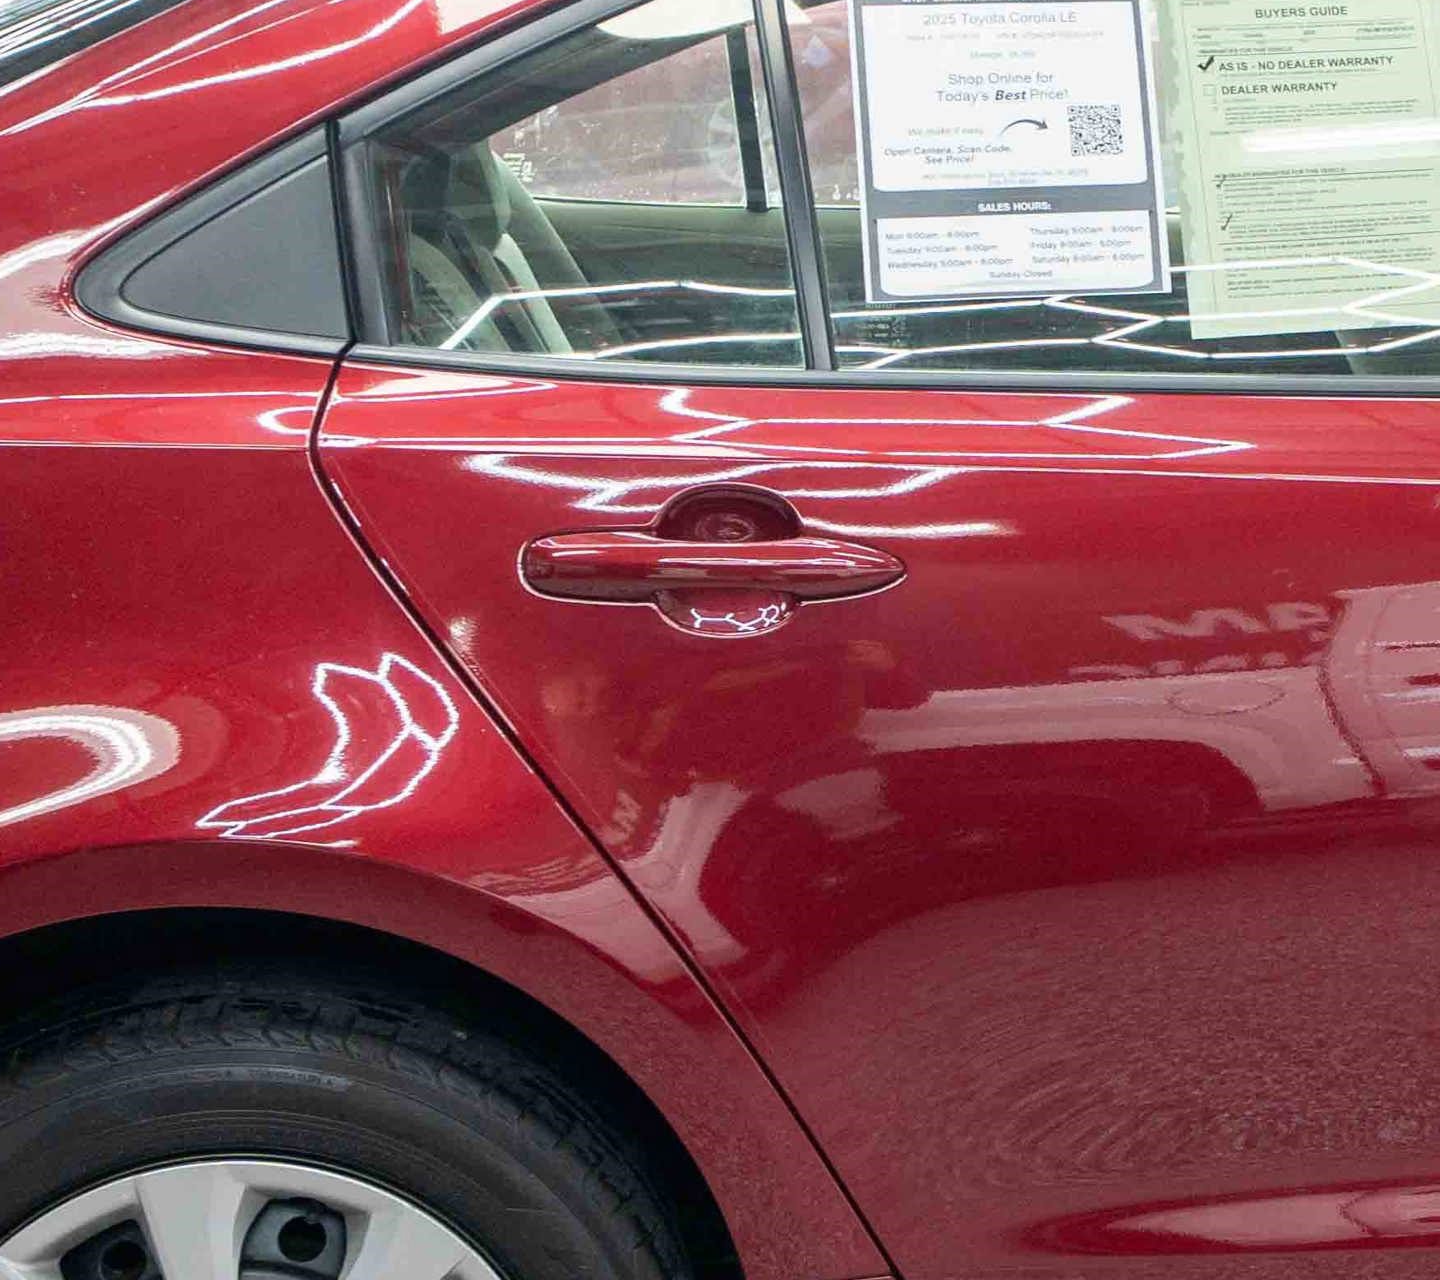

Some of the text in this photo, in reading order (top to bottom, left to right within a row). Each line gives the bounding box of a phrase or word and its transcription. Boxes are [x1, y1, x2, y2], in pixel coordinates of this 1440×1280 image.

[923, 11, 1078, 26] 2025 Toyota Corolla LE
[1255, 5, 1349, 19] BUYERS GUIDE
[1219, 62, 1234, 72] AS
[1237, 62, 1248, 71] IS
[1258, 60, 1275, 71] NO
[1279, 58, 1326, 70] DEALER
[1329, 55, 1394, 68] WARRANTY
[948, 71, 1054, 87] Shop Online for
[935, 88, 1070, 104] Today's Best Price!
[1221, 81, 1338, 96] DEALER WARRANTY
[956, 144, 983, 155] Scan
[925, 155, 944, 165] See
[978, 201, 1052, 212] SALES HOURS:
